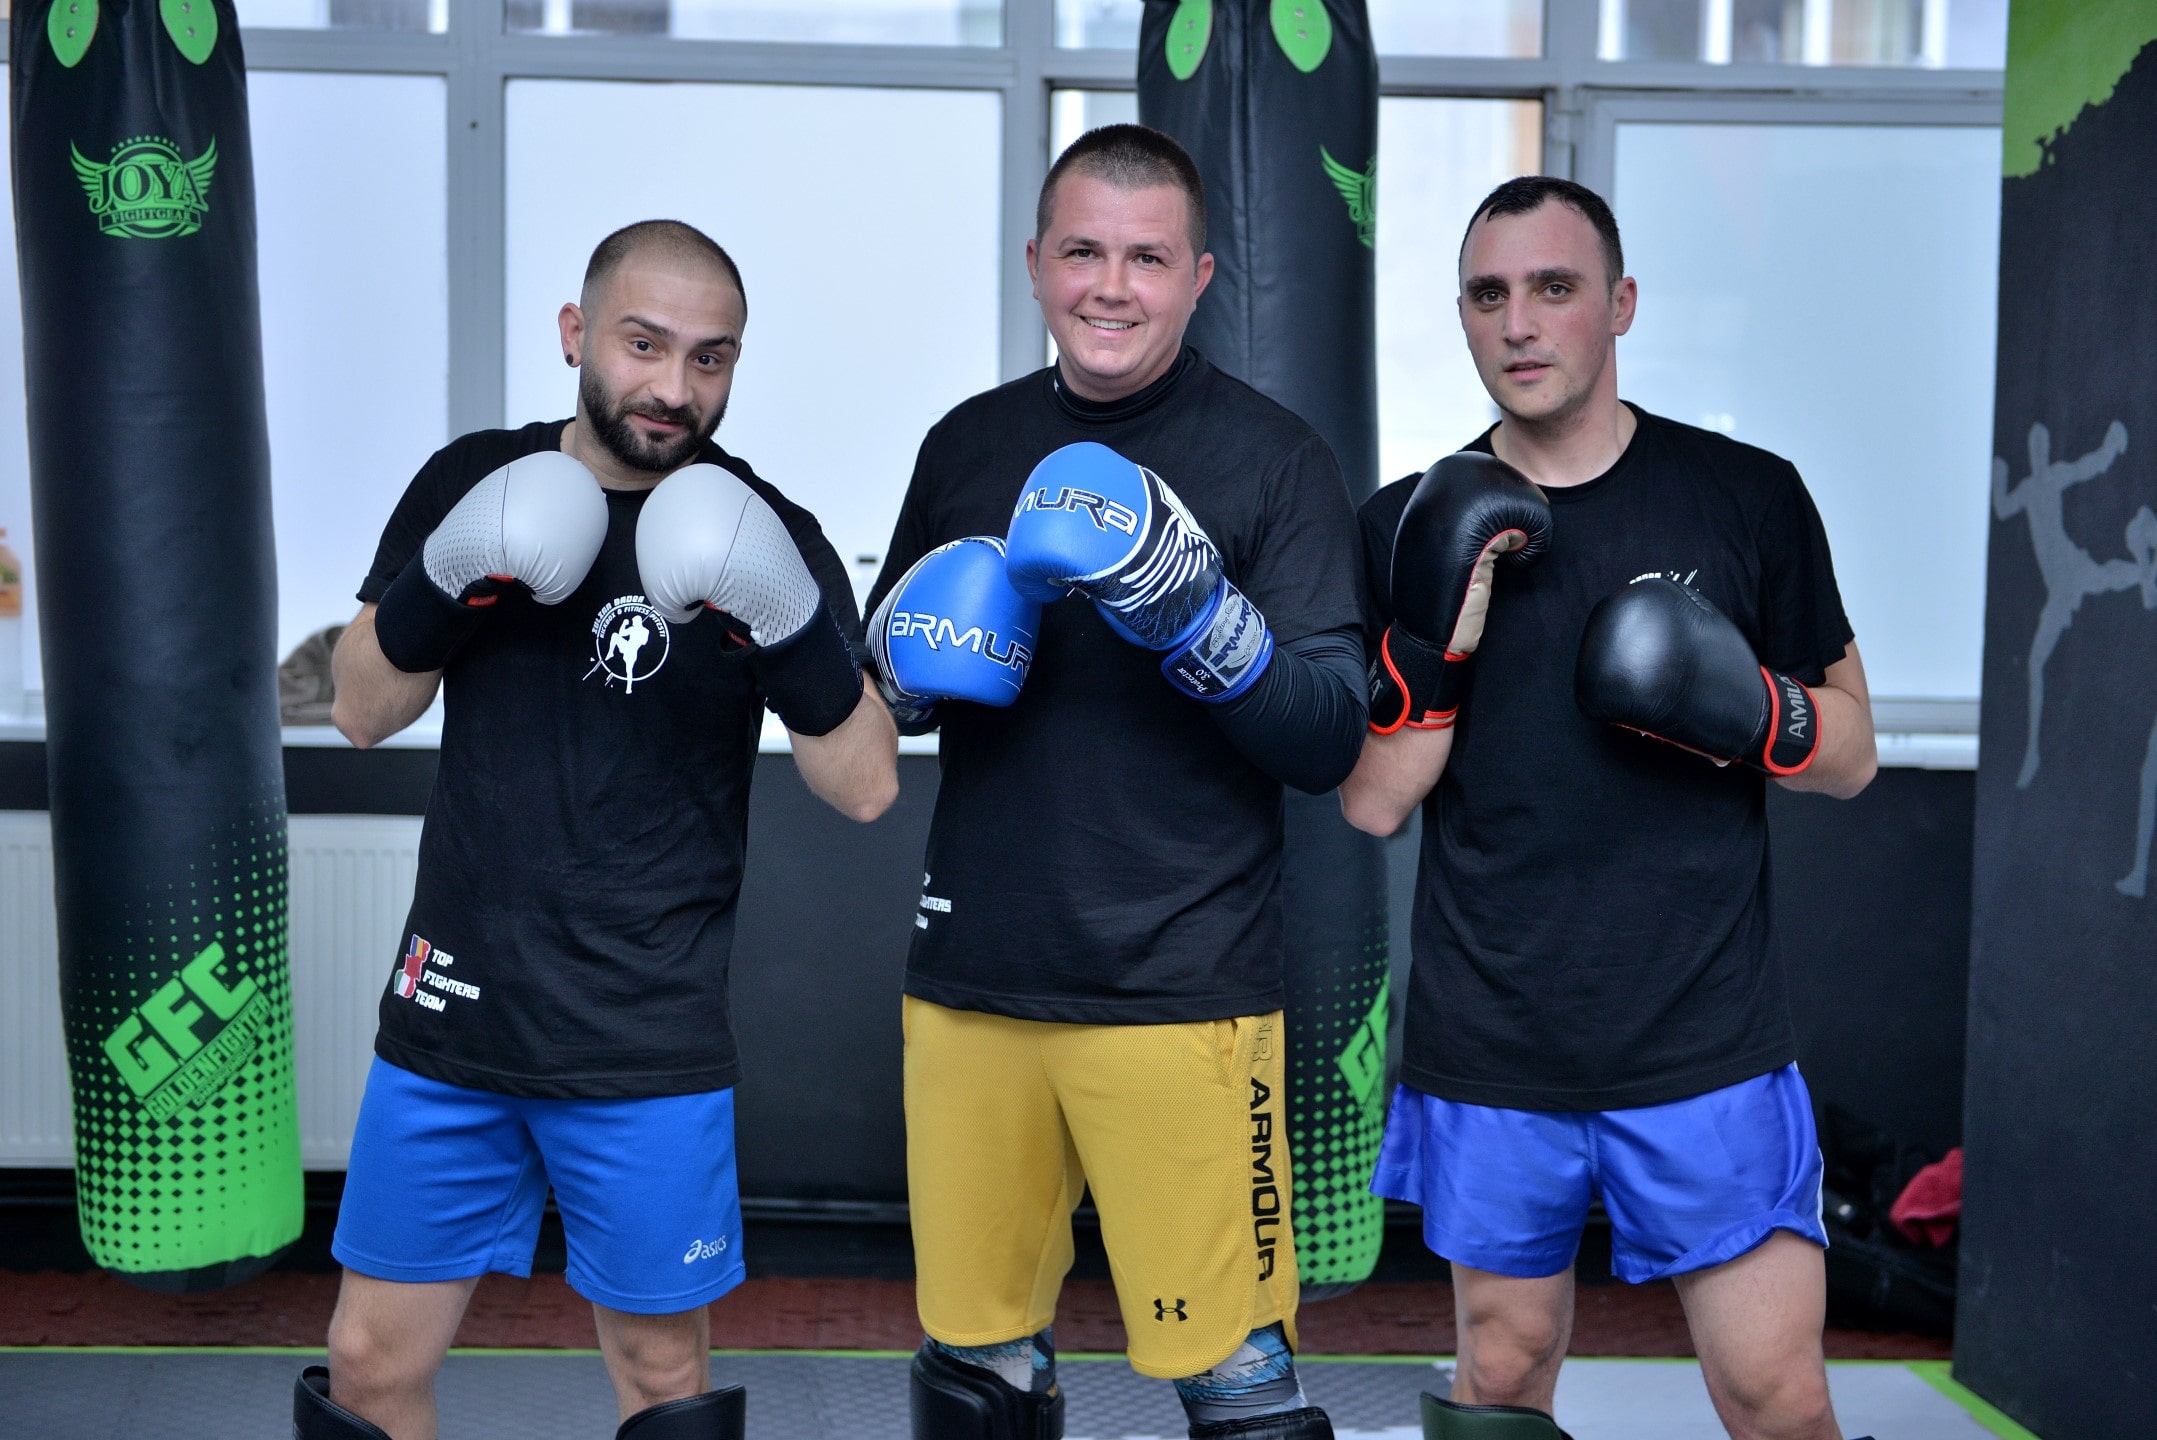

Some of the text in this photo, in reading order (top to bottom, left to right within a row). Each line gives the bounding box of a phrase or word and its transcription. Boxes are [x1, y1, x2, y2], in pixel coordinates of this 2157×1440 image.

[89, 162, 209, 213] JOYA
[111, 208, 191, 223] FIGHTGEAR
[431, 949, 454, 967] TOP
[422, 969, 480, 1000] FIGHTERS
[414, 989, 447, 1012] TEAM
[104, 941, 257, 1099] GFC
[145, 991, 272, 1121] GOLDENFIGHTER
[700, 1235, 727, 1260] asics
